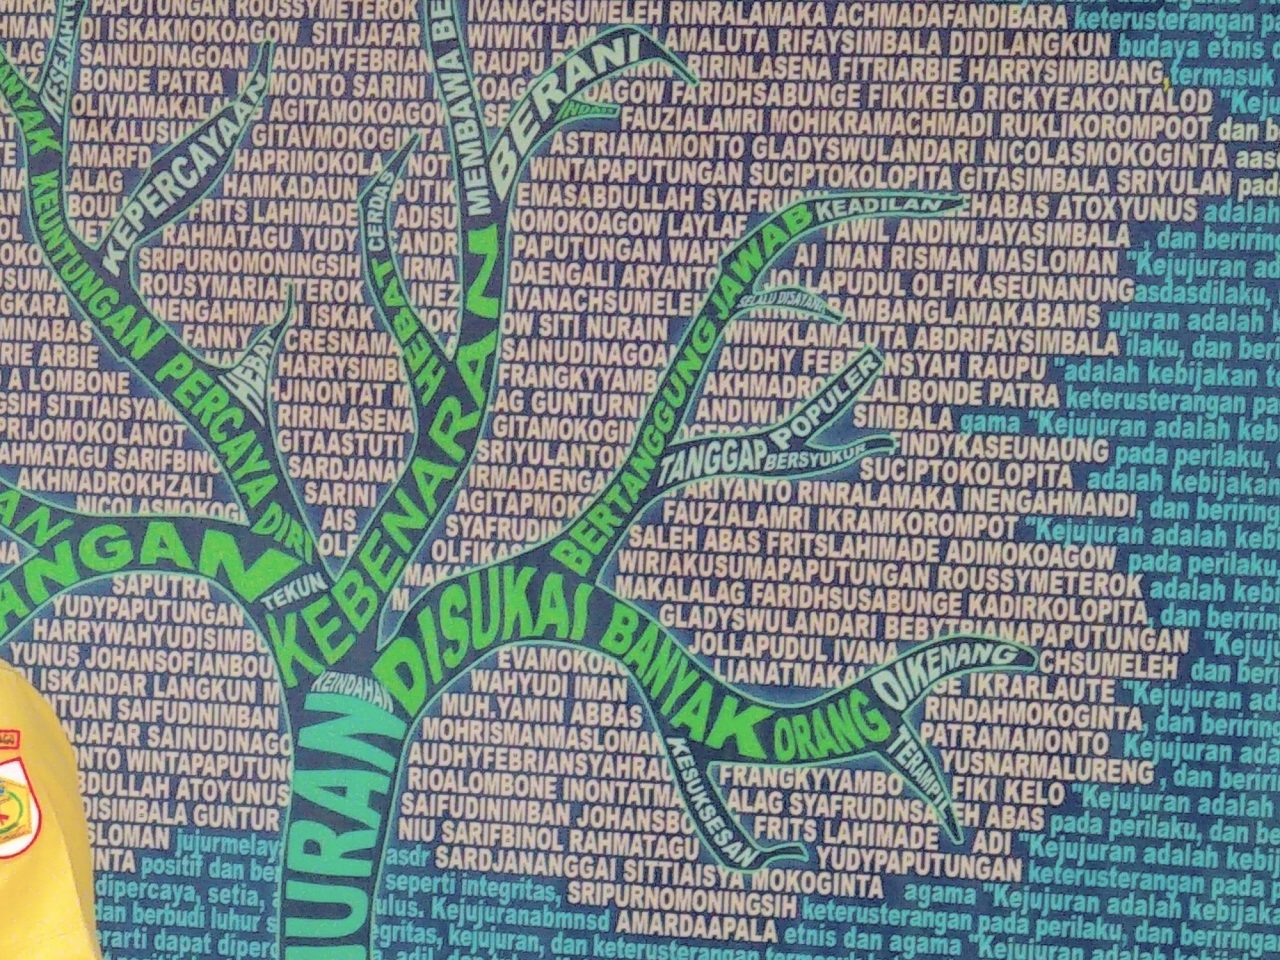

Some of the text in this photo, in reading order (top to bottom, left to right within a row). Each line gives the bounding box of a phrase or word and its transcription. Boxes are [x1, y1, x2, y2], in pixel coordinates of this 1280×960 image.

[669, 1, 827, 26] RINRALAMAKA
[1074, 7, 1254, 38] keterusterangan
[949, 30, 1264, 62] DIDILANGKUN budaya etnis
[80, 68, 223, 94] BONDE PATRA
[868, 84, 975, 109] FIKIKELO
[489, 34, 642, 200] BERANI
[621, 106, 763, 133] FAUZIALAMRI
[437, 49, 492, 217] MEMBAWA
[550, 132, 1228, 168] ASTRIAMAMONTO NICOLASMOKOGINTA
[102, 72, 266, 277] KEPERCAYAAN
[224, 175, 358, 201] HAMKADAUN
[530, 158, 1232, 196] WINTAPAPUTUNGAN SUCIPTOKOLOPITA GITASIMBALA SRIYULAN
[368, 171, 395, 252] CERDAS
[815, 198, 942, 221] KEADILAN
[1057, 195, 1197, 222] ATOXYUNUS
[163, 224, 359, 251] RAHMATAGU YUDY
[31, 168, 167, 361] KEUNTUNGAN
[892, 247, 978, 271] RISMAN
[987, 249, 1118, 276] MASLOMAN
[372, 257, 446, 406] HEBAT
[39, 345, 99, 368] ARBIE
[968, 355, 1046, 379] RAUPU
[549, 203, 814, 577] BERTANGGUNG JAWAB
[770, 352, 879, 452] POPULER
[1154, 416, 1230, 439] adalah
[155, 352, 314, 565] PERCAYA DIRI
[265, 224, 499, 687] KEBENARAN
[278, 430, 404, 457] GITAASTUTI
[762, 444, 867, 471] BERSYUKUR
[657, 439, 768, 487] TANGGAP
[304, 482, 376, 507] SARINI
[947, 543, 1181, 575] ADIMOKOAGOW pada
[112, 575, 210, 599] SAPUTRA
[260, 572, 328, 611] TEKUN
[937, 566, 1143, 598] ROUSSYMETEROK
[53, 595, 244, 626] YUDYPAPUTUNGAN
[371, 563, 891, 762] DISUKAI BANYAK ORANG
[871, 643, 1020, 711] DIKENANG
[1039, 651, 1178, 679] CHSUMELEH
[41, 669, 256, 703] ISKANDAR LANGKUN
[471, 670, 628, 701] WAHYUDI IMAN
[970, 675, 1115, 702] IKRARLAUTE
[570, 701, 643, 728] ABBAS
[666, 738, 761, 868] KESUKSESAN
[953, 777, 1064, 805] FIKI KELO
[569, 829, 699, 860] RAHMATAGU
[141, 856, 245, 882] positif dan
[616, 909, 778, 943] AMARDAAPALA
